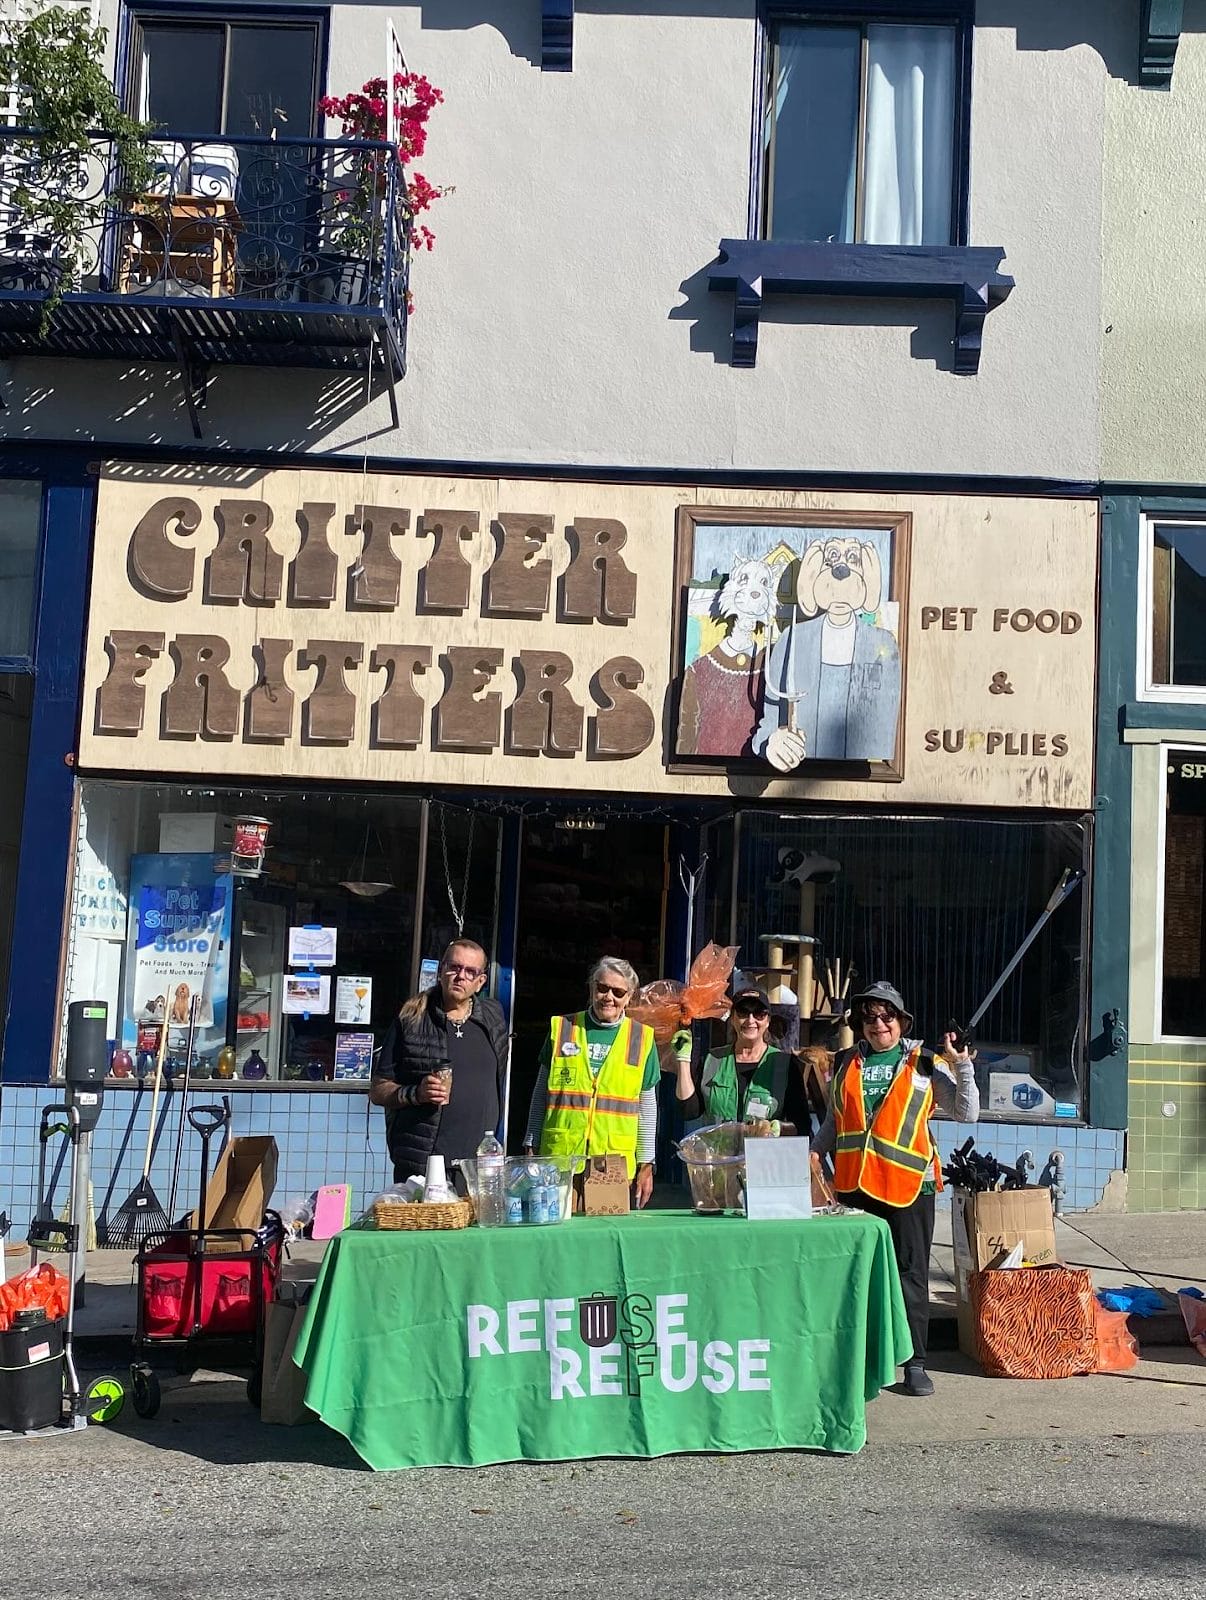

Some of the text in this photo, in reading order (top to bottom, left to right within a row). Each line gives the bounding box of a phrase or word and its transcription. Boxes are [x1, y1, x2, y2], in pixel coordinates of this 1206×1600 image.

[128, 497, 637, 625] CRITTER
[921, 606, 1083, 635] PET FOOD
[94, 630, 655, 761] FRITTERS
[988, 671, 1015, 695] &
[924, 729, 1069, 757] SUPLIES
[166, 889, 199, 910] Pet
[144, 909, 222, 933] Supply
[154, 935, 209, 953] Store
[550, 1339, 770, 1400] REFUSE
